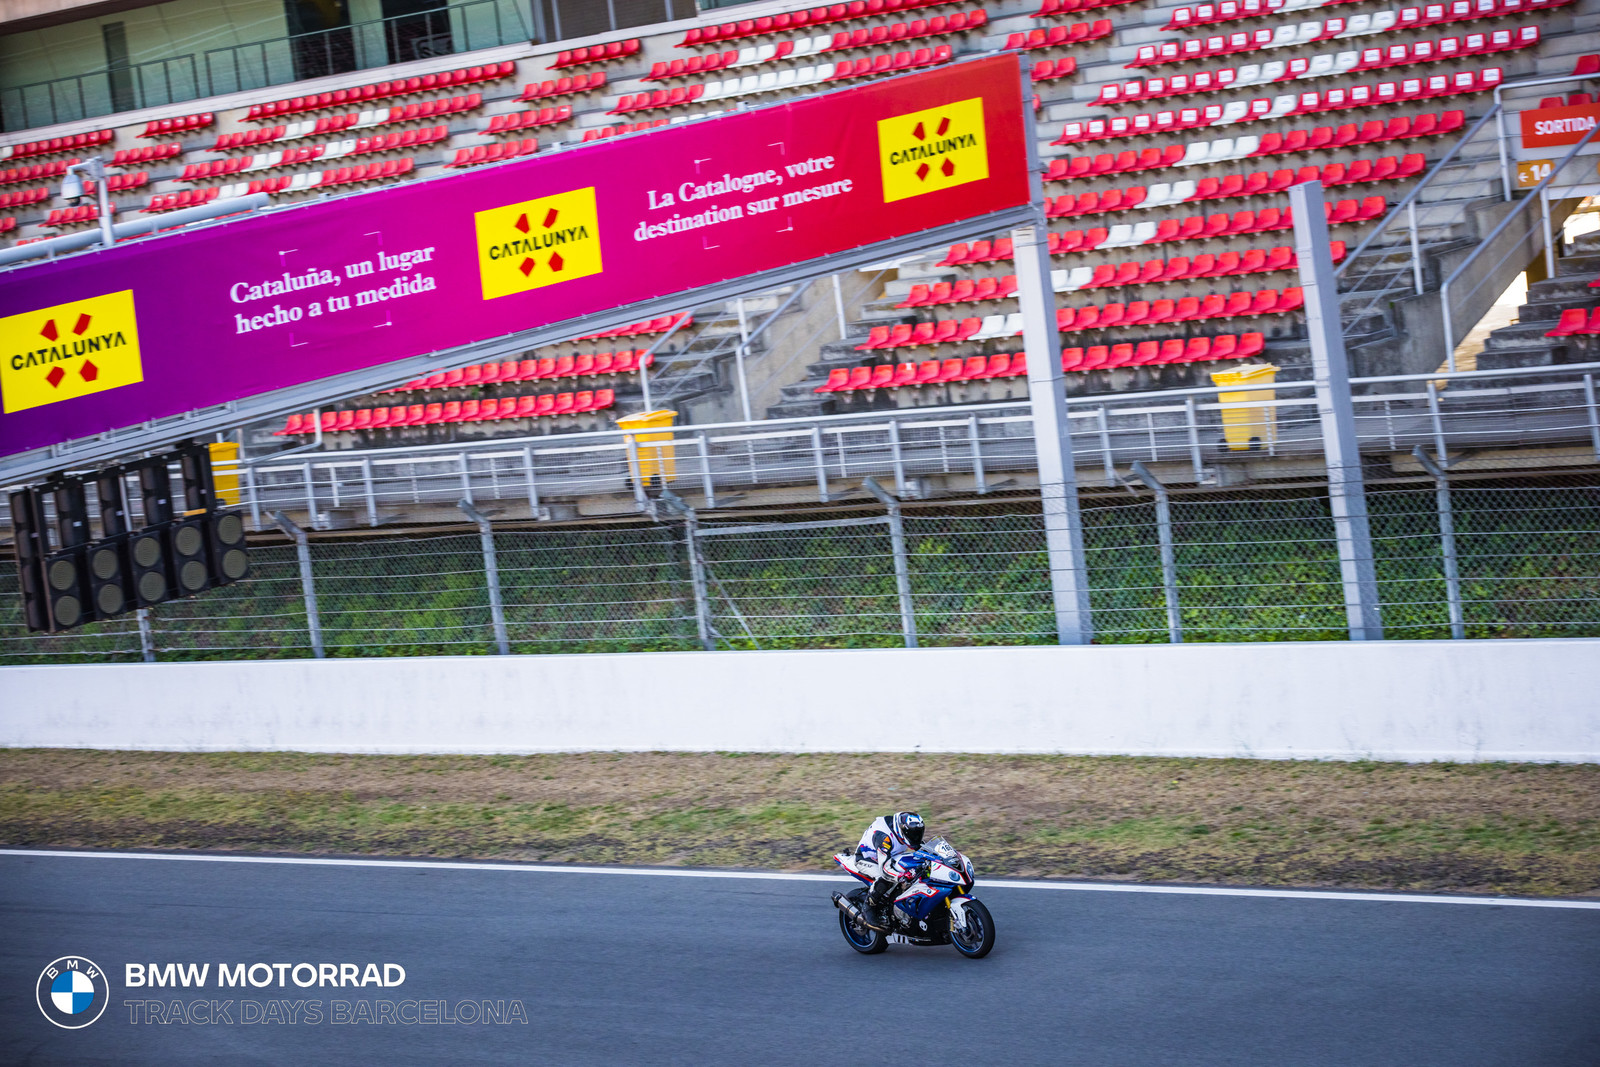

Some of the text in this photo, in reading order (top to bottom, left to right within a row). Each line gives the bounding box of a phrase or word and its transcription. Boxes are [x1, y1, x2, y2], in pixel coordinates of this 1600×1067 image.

[1534, 116, 1597, 135] SORTIDA
[889, 133, 977, 165] CATALUNYA
[647, 155, 835, 210] La Catalogne, votre
[1530, 164, 1552, 181] 14
[633, 178, 853, 242] destination sur mesure
[489, 225, 589, 260] CATALUNYA
[229, 246, 435, 303] Cataluña, un lugar
[234, 273, 437, 334] hecho a tu medida
[11, 331, 127, 370] CATALUNYA
